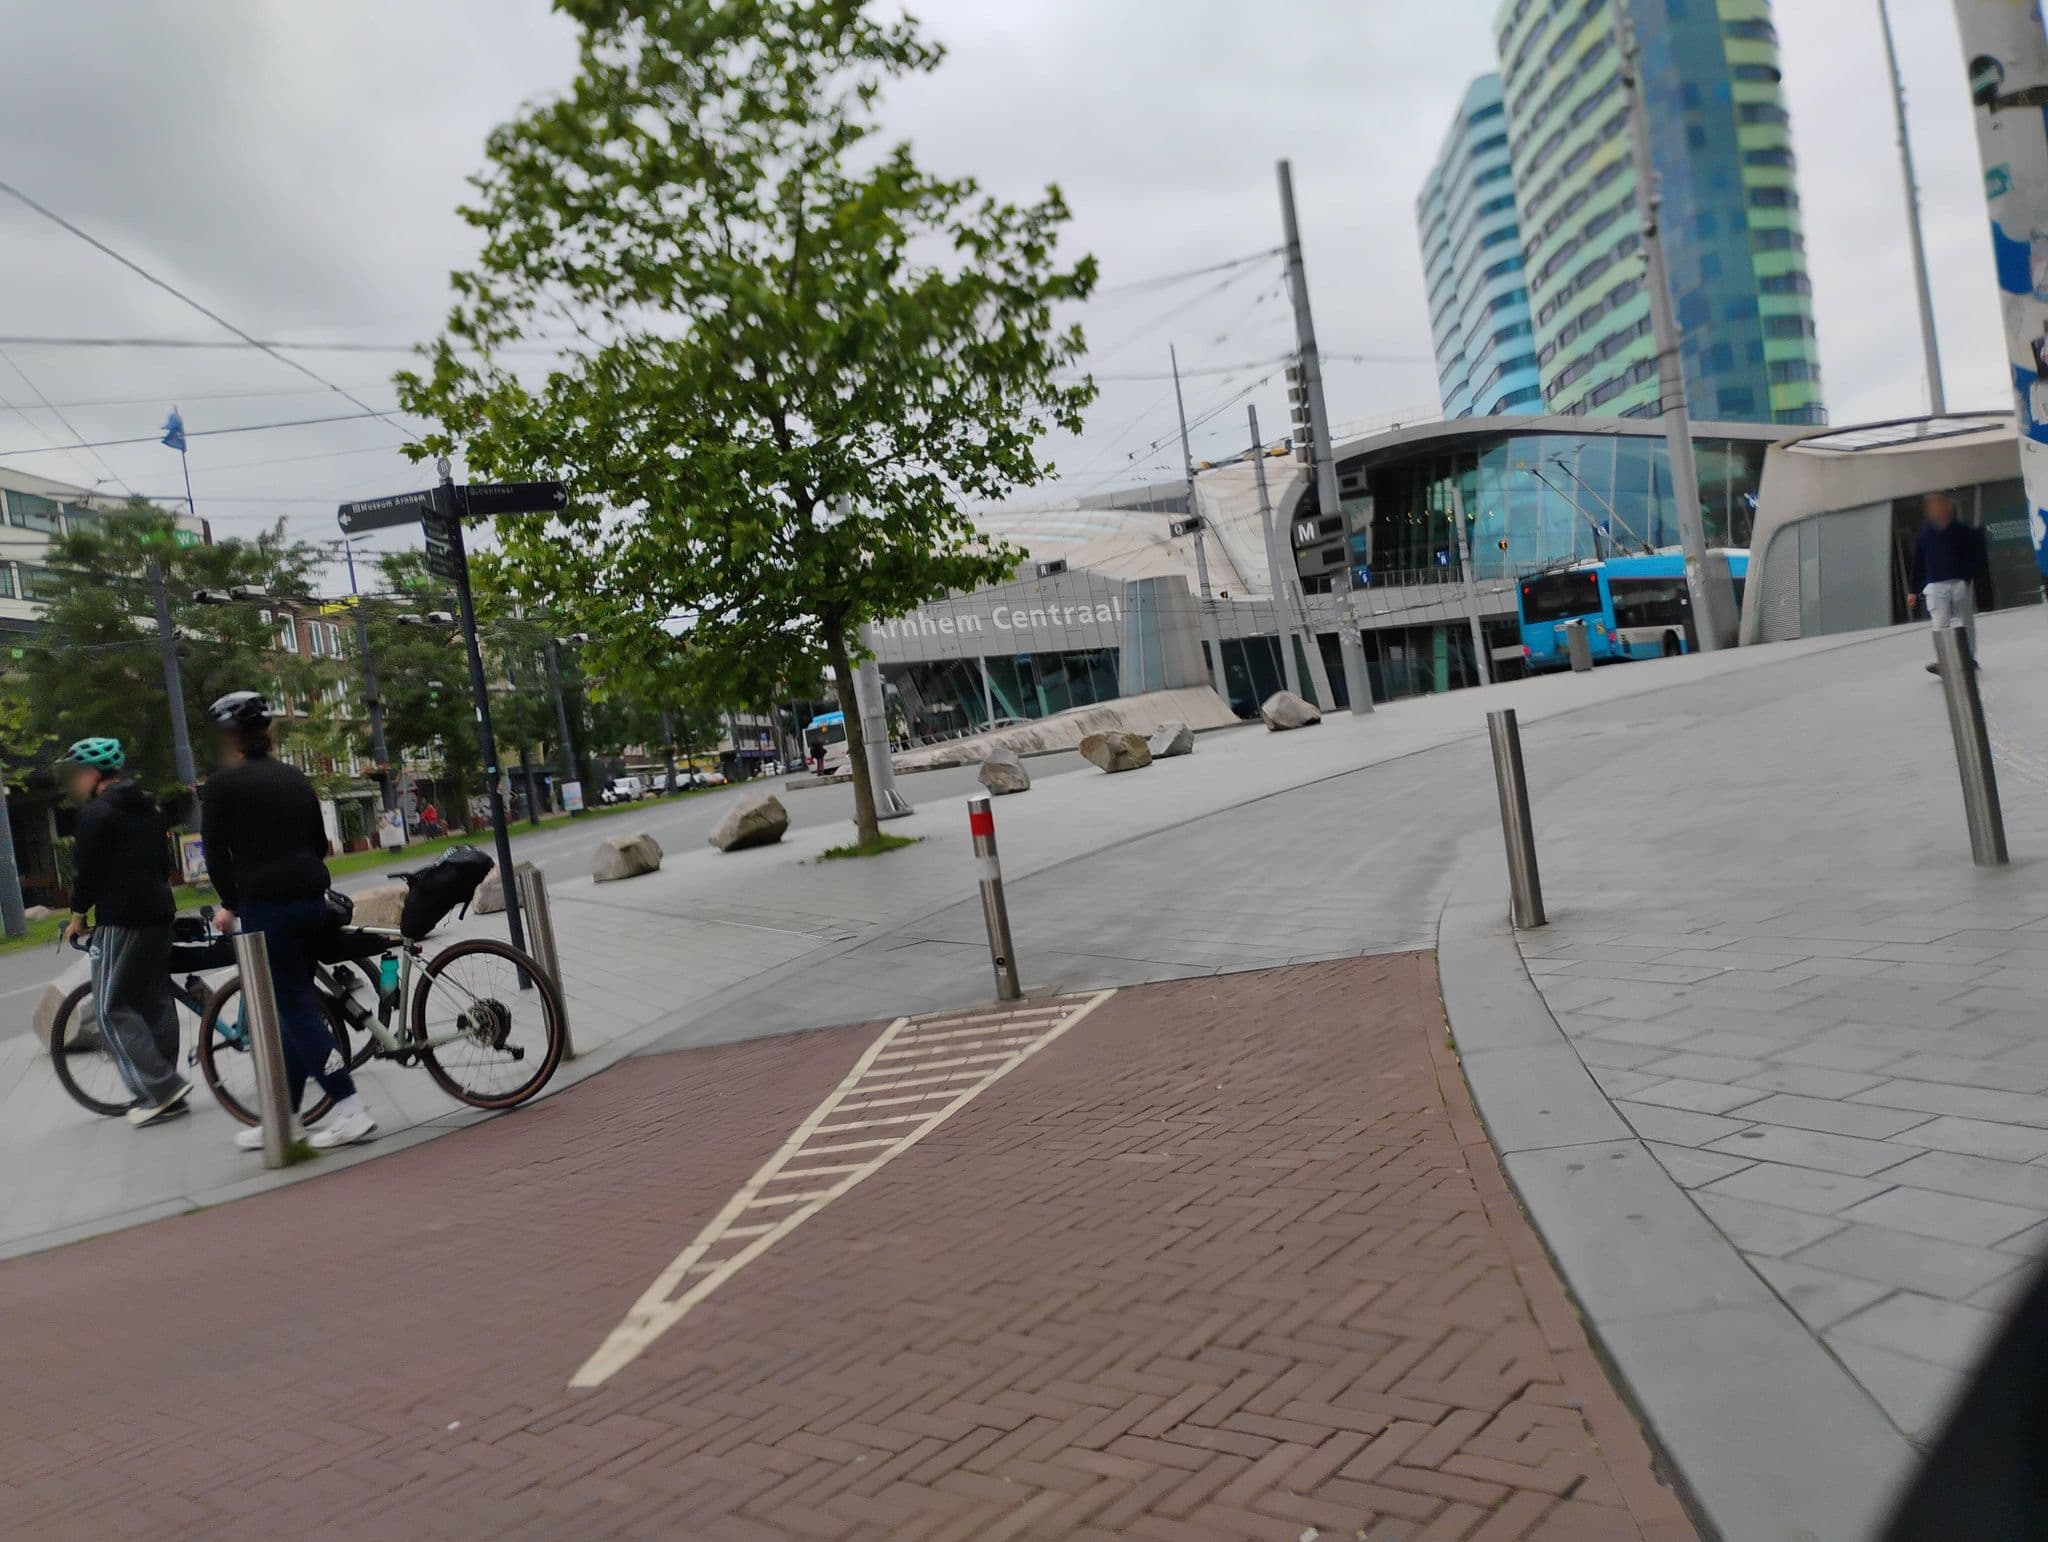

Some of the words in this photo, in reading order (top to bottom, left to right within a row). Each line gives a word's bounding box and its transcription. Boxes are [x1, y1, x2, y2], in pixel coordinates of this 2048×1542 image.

[361, 500, 393, 512] Museum
[395, 494, 426, 506] Arnhem
[1298, 521, 1316, 543] M
[992, 595, 1122, 632] Centraal
